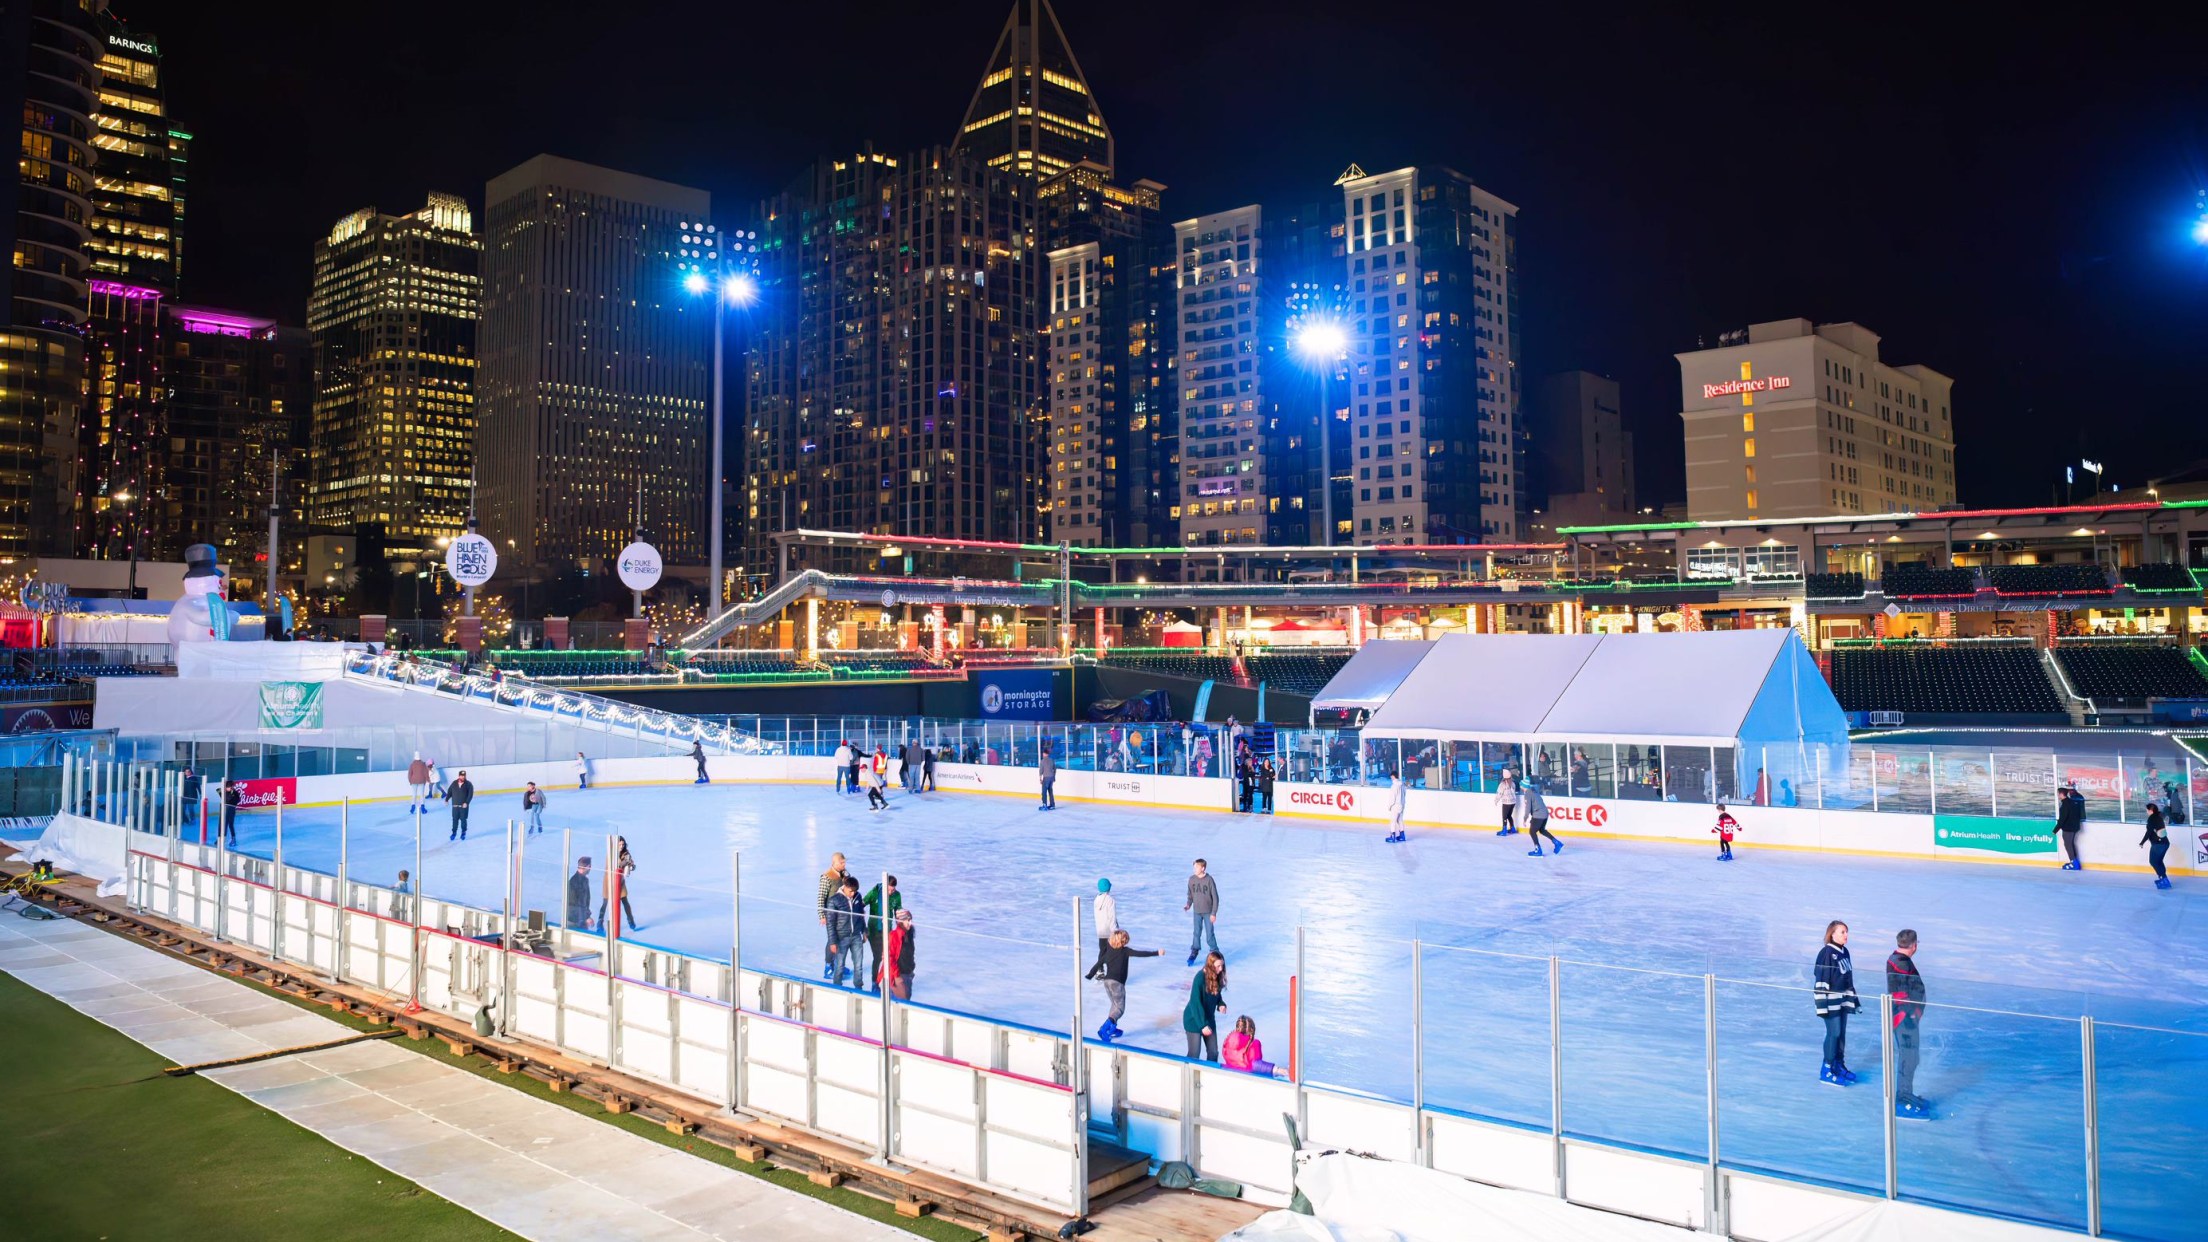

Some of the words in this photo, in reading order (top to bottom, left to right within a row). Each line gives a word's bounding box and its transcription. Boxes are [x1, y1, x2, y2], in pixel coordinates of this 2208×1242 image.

[109, 35, 153, 53] BARINGS
[1703, 380, 1765, 398] Residence
[1768, 376, 1790, 390] Inn
[456, 542, 479, 553] BLUE
[456, 553, 487, 564] HAVEN
[456, 564, 487, 575] POOLS
[42, 582, 71, 597] DUKE
[41, 599, 82, 613] ENERGY
[1638, 605, 1671, 613] KNIGHTS
[1004, 689, 1051, 701] morningstar
[1004, 700, 1051, 710] STORAGE
[69, 708, 90, 726] We
[2005, 772, 2041, 783] TRUIST
[1107, 782, 1130, 790] TRUIST
[1290, 791, 1333, 805] CIRCLE
[1339, 793, 1353, 809] K
[1588, 806, 1606, 826] K
[2005, 833, 2022, 841] live
[2022, 834, 2054, 844] joyfully
